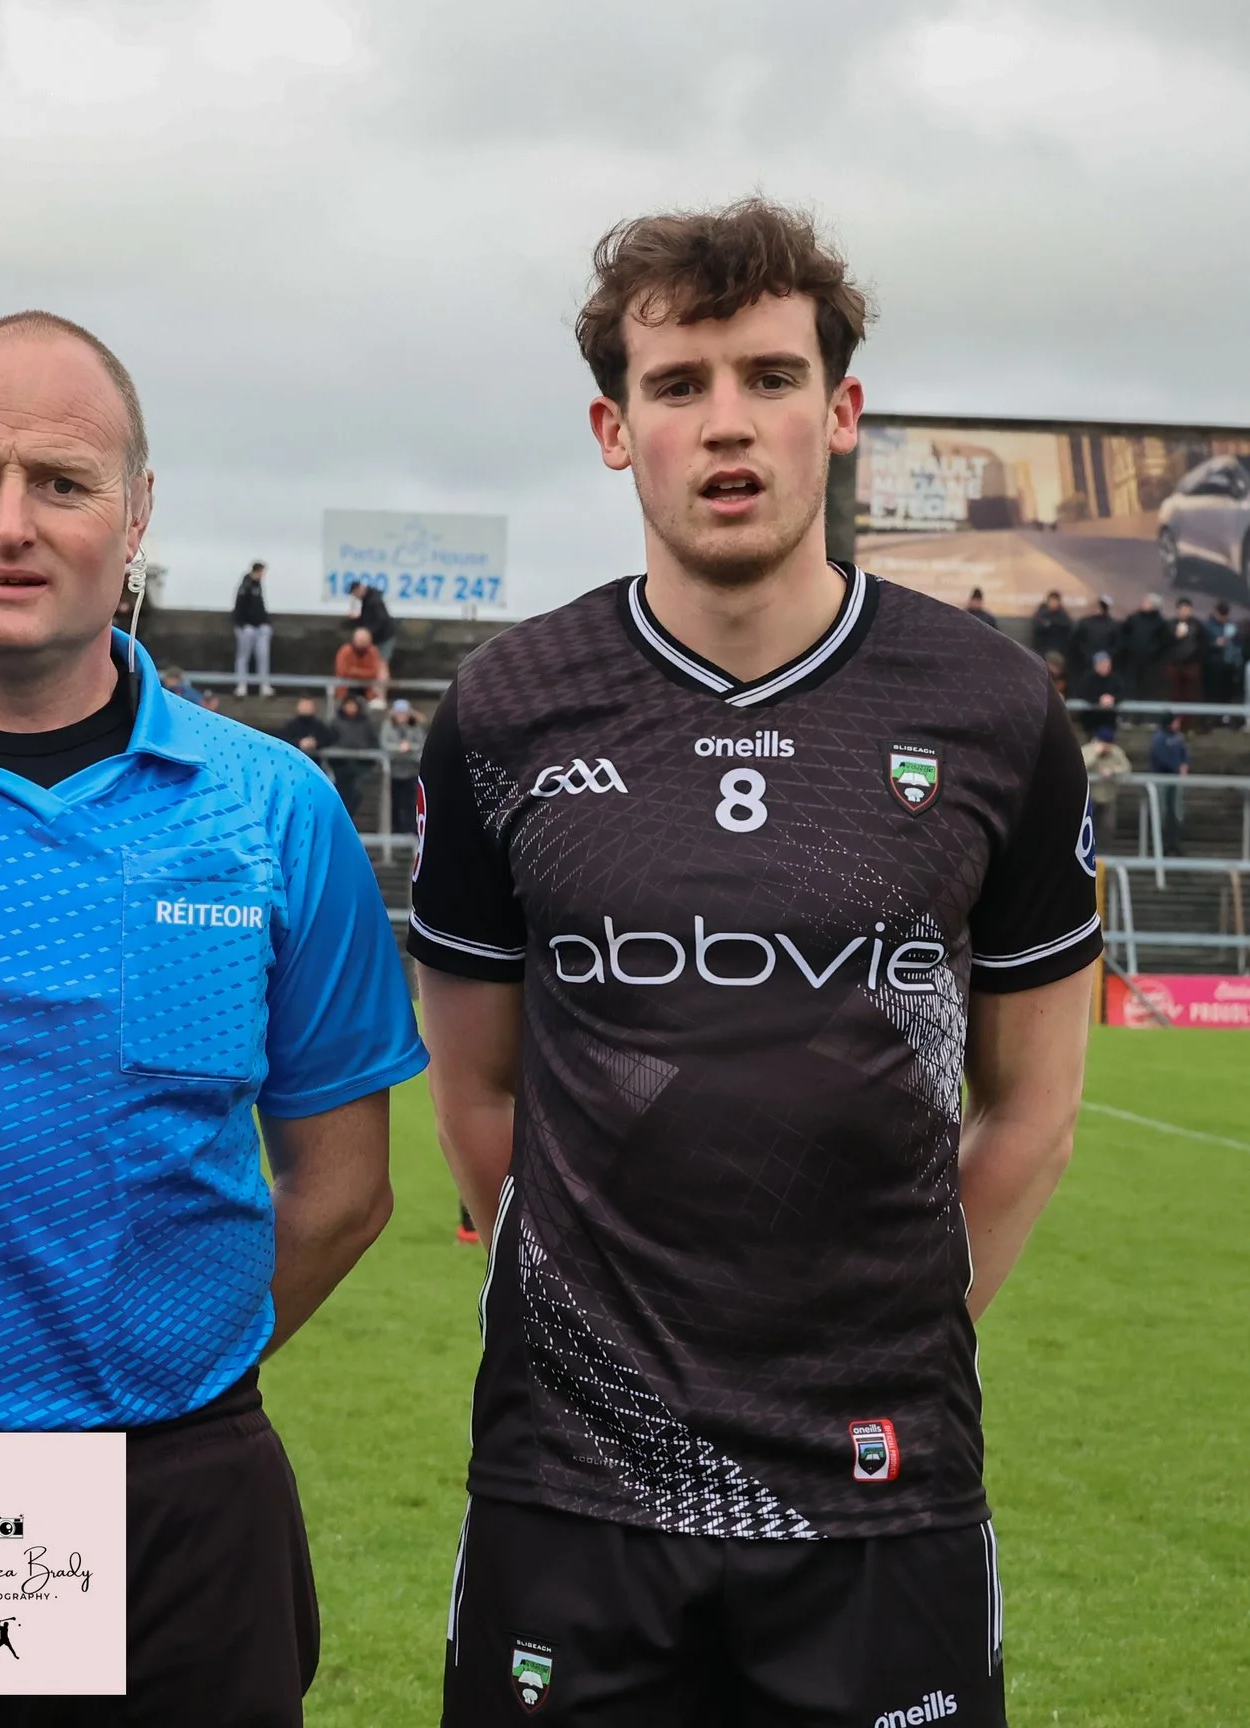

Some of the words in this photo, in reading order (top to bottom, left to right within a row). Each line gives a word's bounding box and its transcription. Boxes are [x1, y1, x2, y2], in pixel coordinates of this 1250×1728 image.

[398, 572, 445, 600] 247
[453, 574, 503, 602] 247
[715, 767, 768, 833] 8
[155, 900, 263, 929] RÉITEOIR
[549, 914, 946, 992] abbvie
